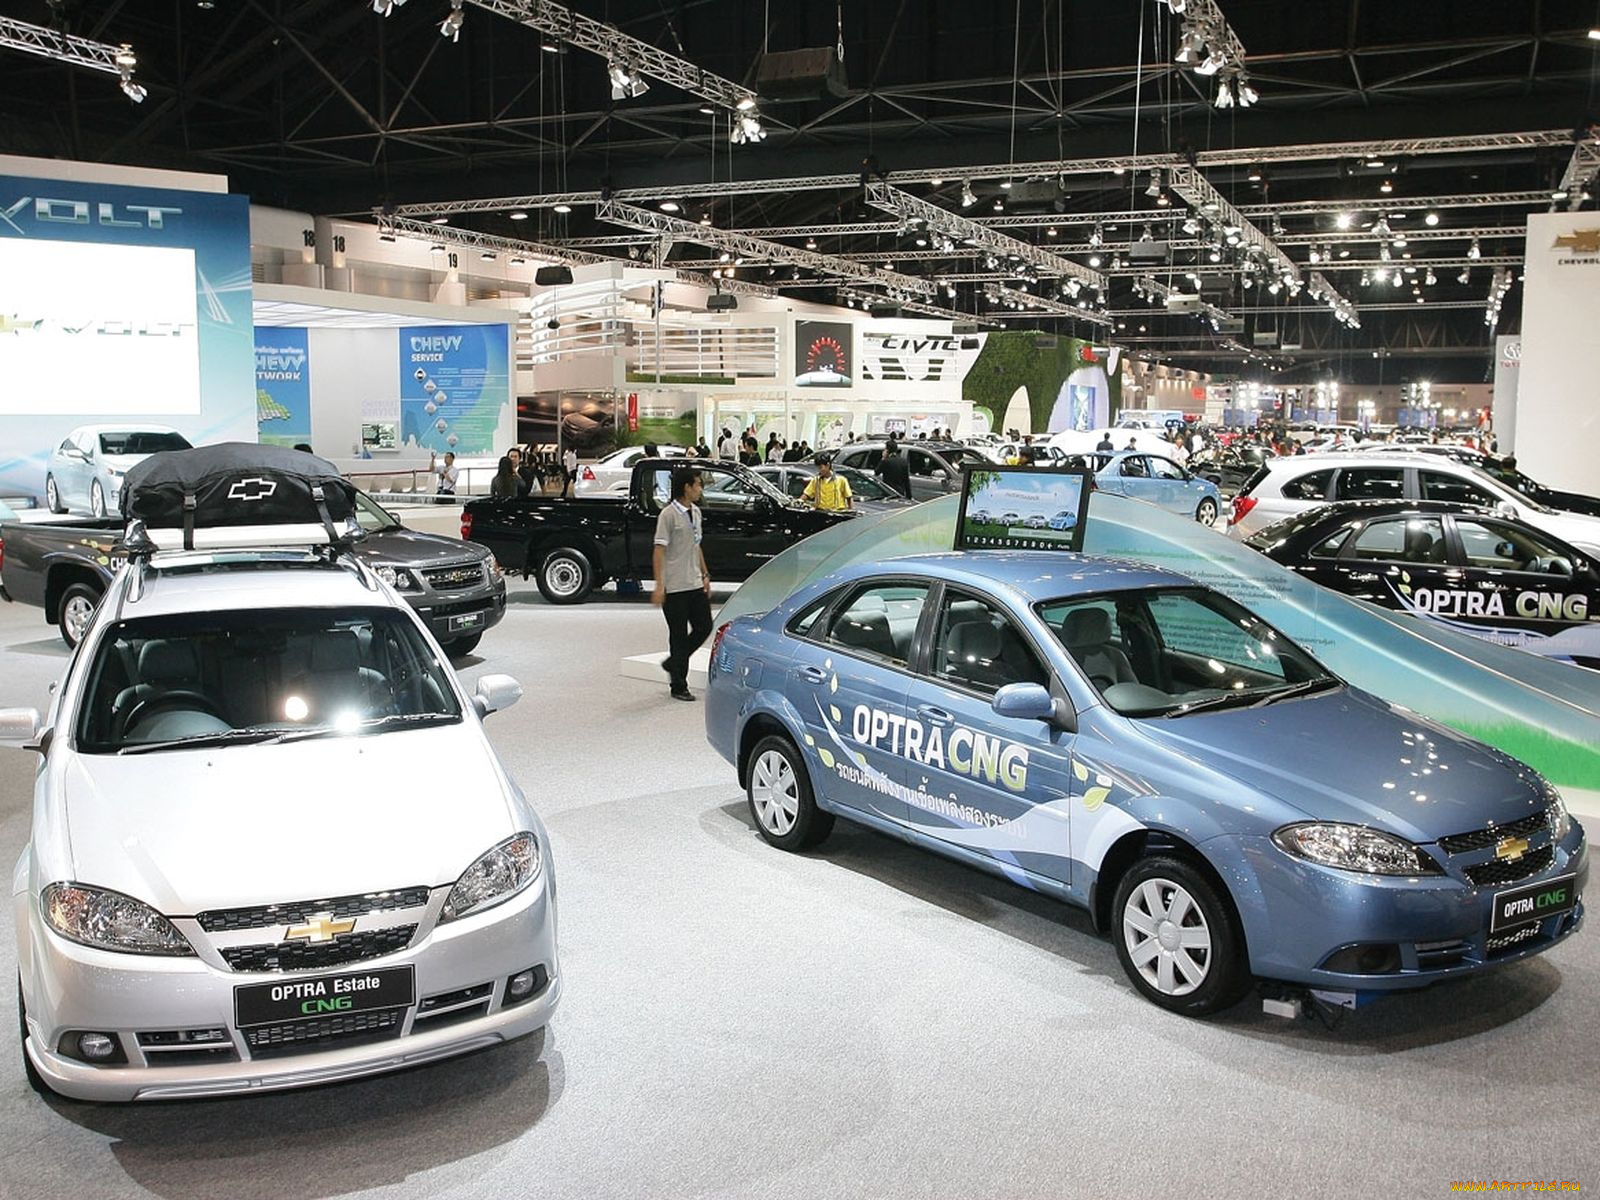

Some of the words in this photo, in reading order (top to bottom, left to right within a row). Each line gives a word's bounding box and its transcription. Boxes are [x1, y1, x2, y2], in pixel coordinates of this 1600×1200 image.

[302, 229, 315, 247] 18
[332, 235, 345, 253] 18
[448, 252, 458, 268] 19
[410, 335, 463, 352] CHEVY
[882, 338, 959, 354] CIVIC
[411, 353, 444, 362] SERVICE
[110, 557, 128, 571] CH
[1414, 588, 1505, 616] OPTRA
[1516, 591, 1589, 621] CNG
[852, 704, 946, 769] OPTRA
[947, 728, 1029, 792] CNG
[1504, 897, 1534, 918] OPTRA
[1536, 887, 1566, 908] CNG
[271, 981, 326, 1002] OPTRA
[334, 976, 381, 994] Estate
[301, 995, 353, 1015] CNG
